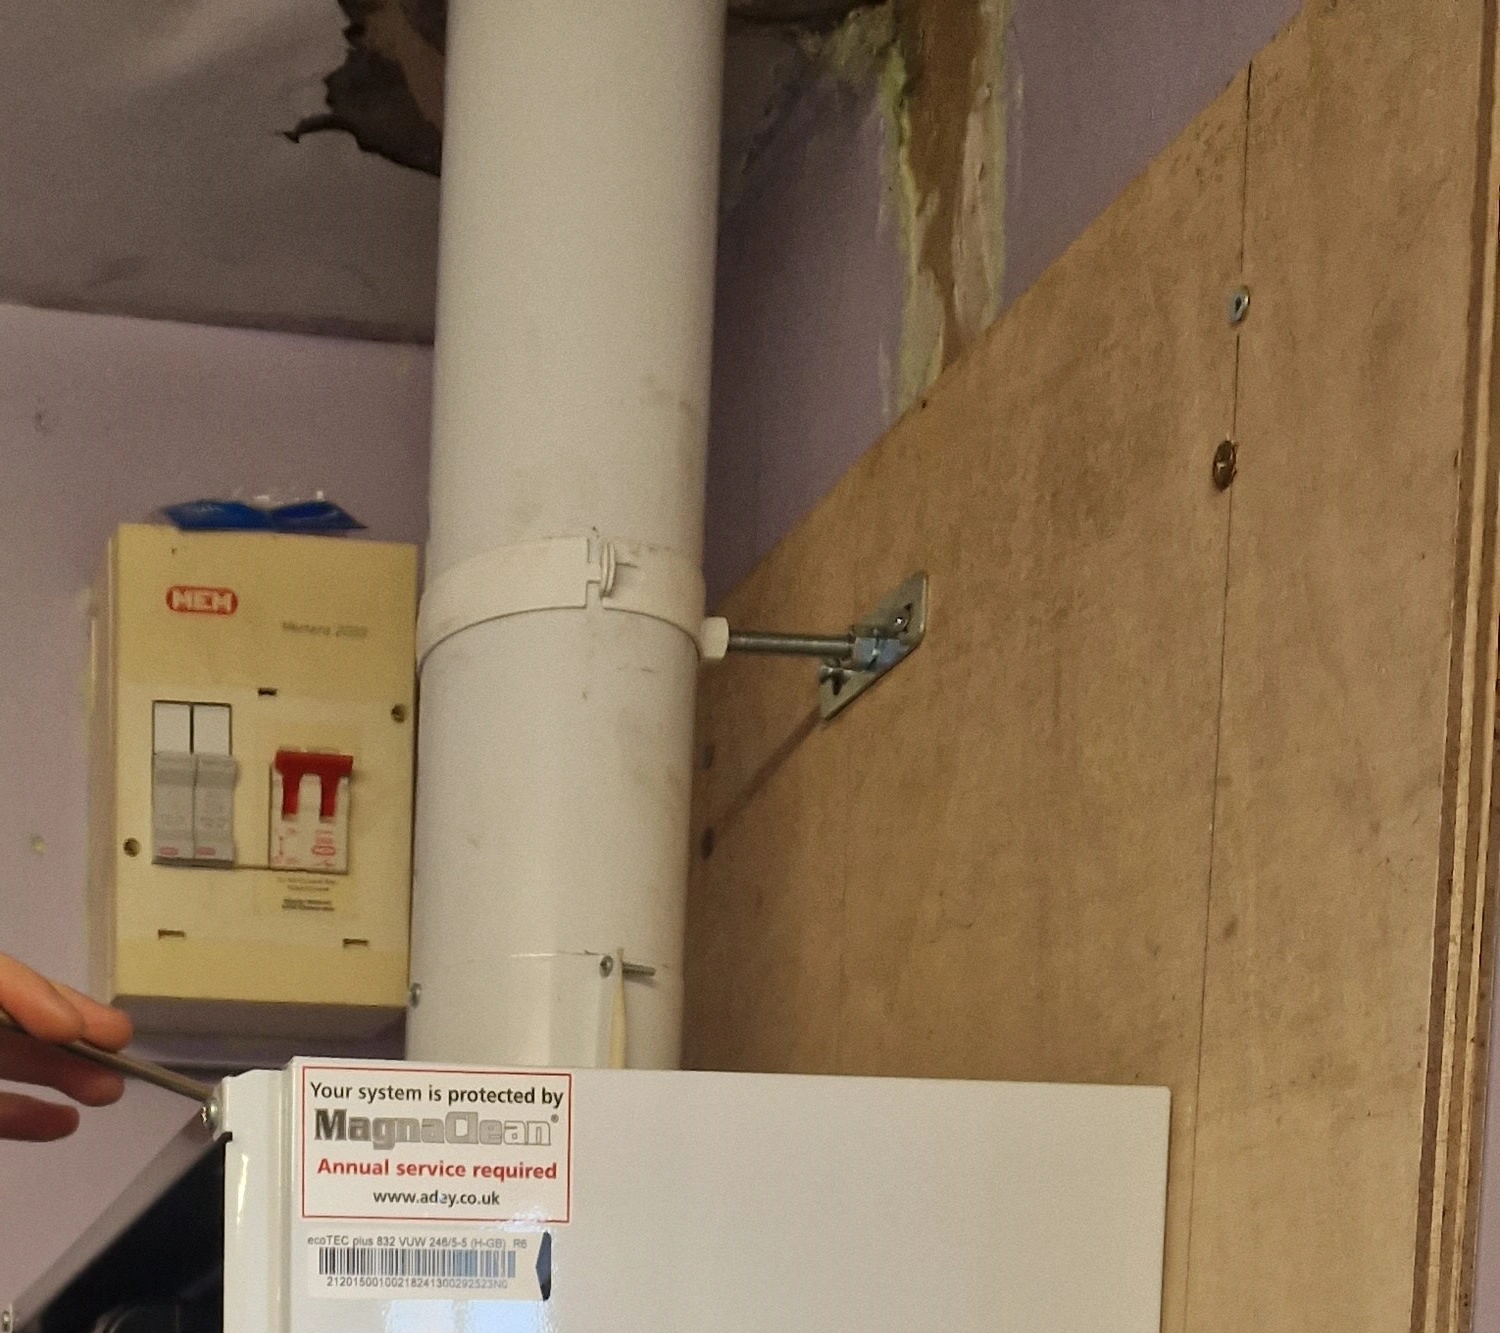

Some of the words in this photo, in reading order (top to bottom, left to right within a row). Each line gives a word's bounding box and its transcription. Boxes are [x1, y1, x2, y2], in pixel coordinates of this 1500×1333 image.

[171, 588, 234, 612] MEM
[310, 1082, 353, 1101] Your
[358, 1086, 422, 1106] system
[429, 1085, 442, 1102] is
[448, 1087, 535, 1107] protected
[542, 1087, 564, 1109] by
[317, 1158, 389, 1176] Annual
[396, 1161, 466, 1177] service
[472, 1162, 557, 1182] required
[373, 1189, 500, 1207] www.adey.co.uk
[307, 1235, 349, 1246] ecoTEC
[353, 1236, 374, 1249] plus
[377, 1236, 396, 1246] 832
[399, 1236, 426, 1247] VUW
